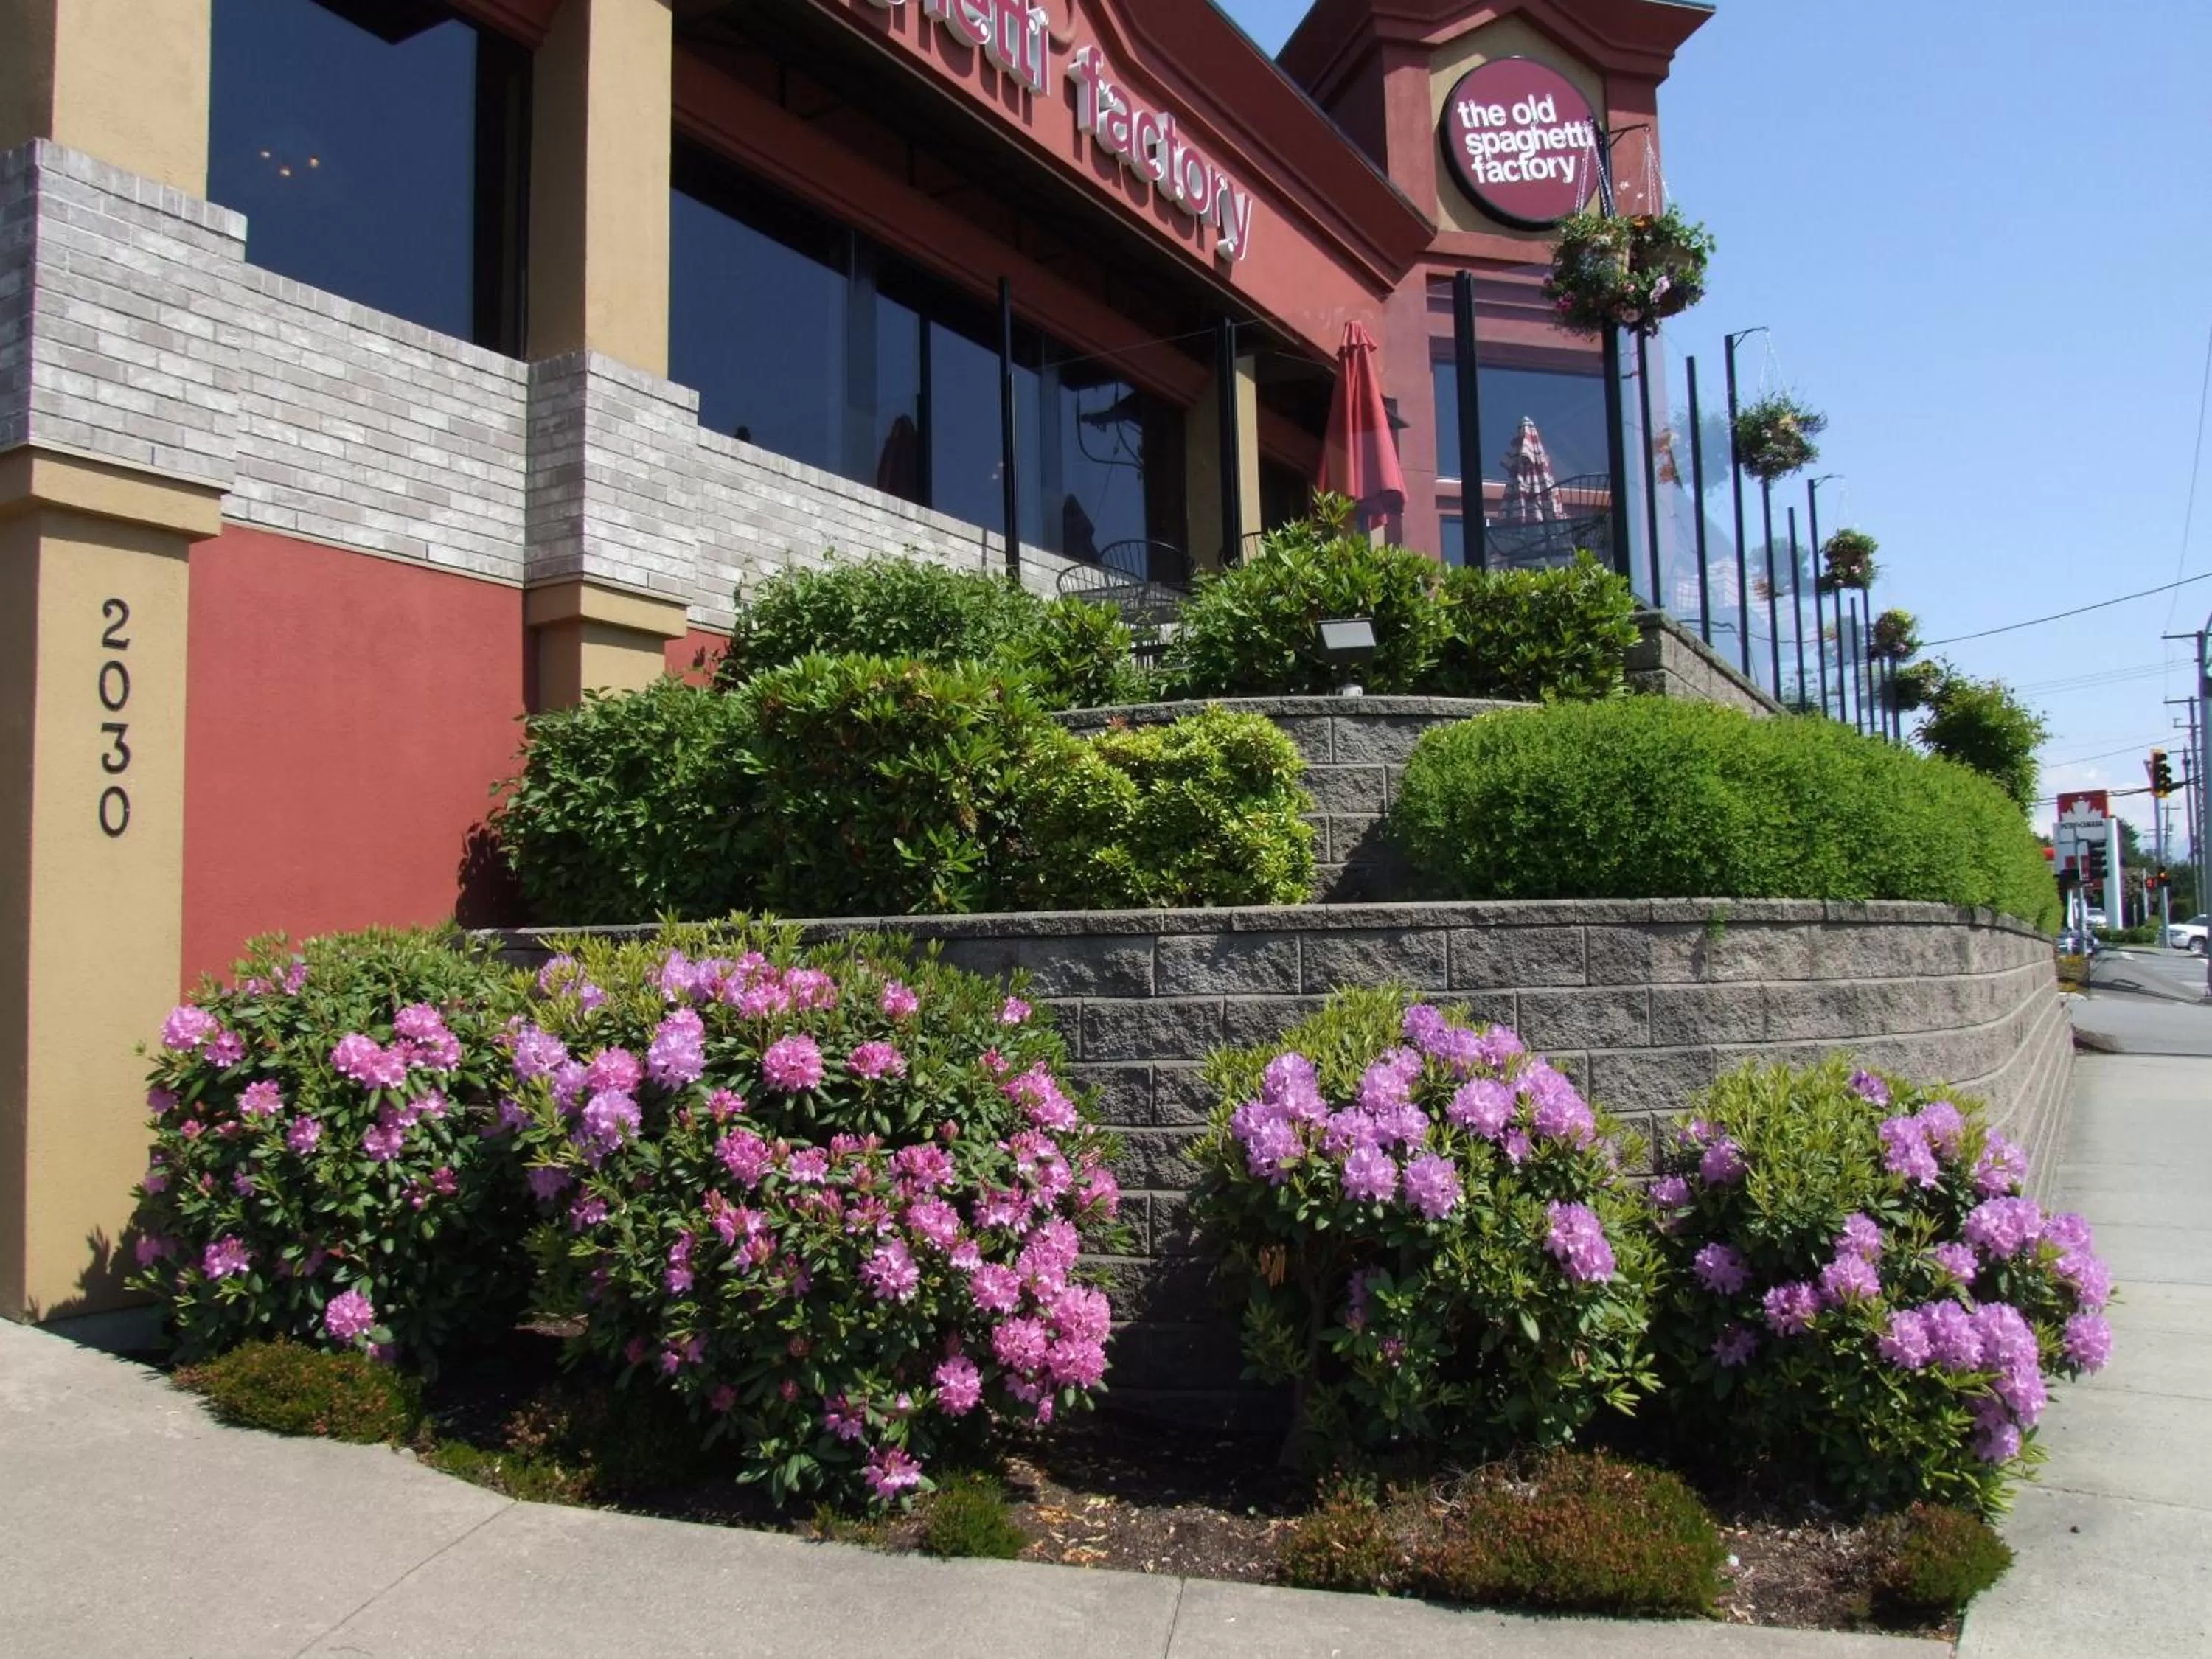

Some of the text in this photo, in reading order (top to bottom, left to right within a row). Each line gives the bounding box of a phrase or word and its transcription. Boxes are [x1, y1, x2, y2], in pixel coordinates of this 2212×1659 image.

[920, 0, 1253, 261] etti factory
[1458, 94, 1557, 128] the old
[1465, 121, 1595, 160] spaghetti
[1472, 153, 1576, 184] factory
[99, 598, 131, 838] 2030
